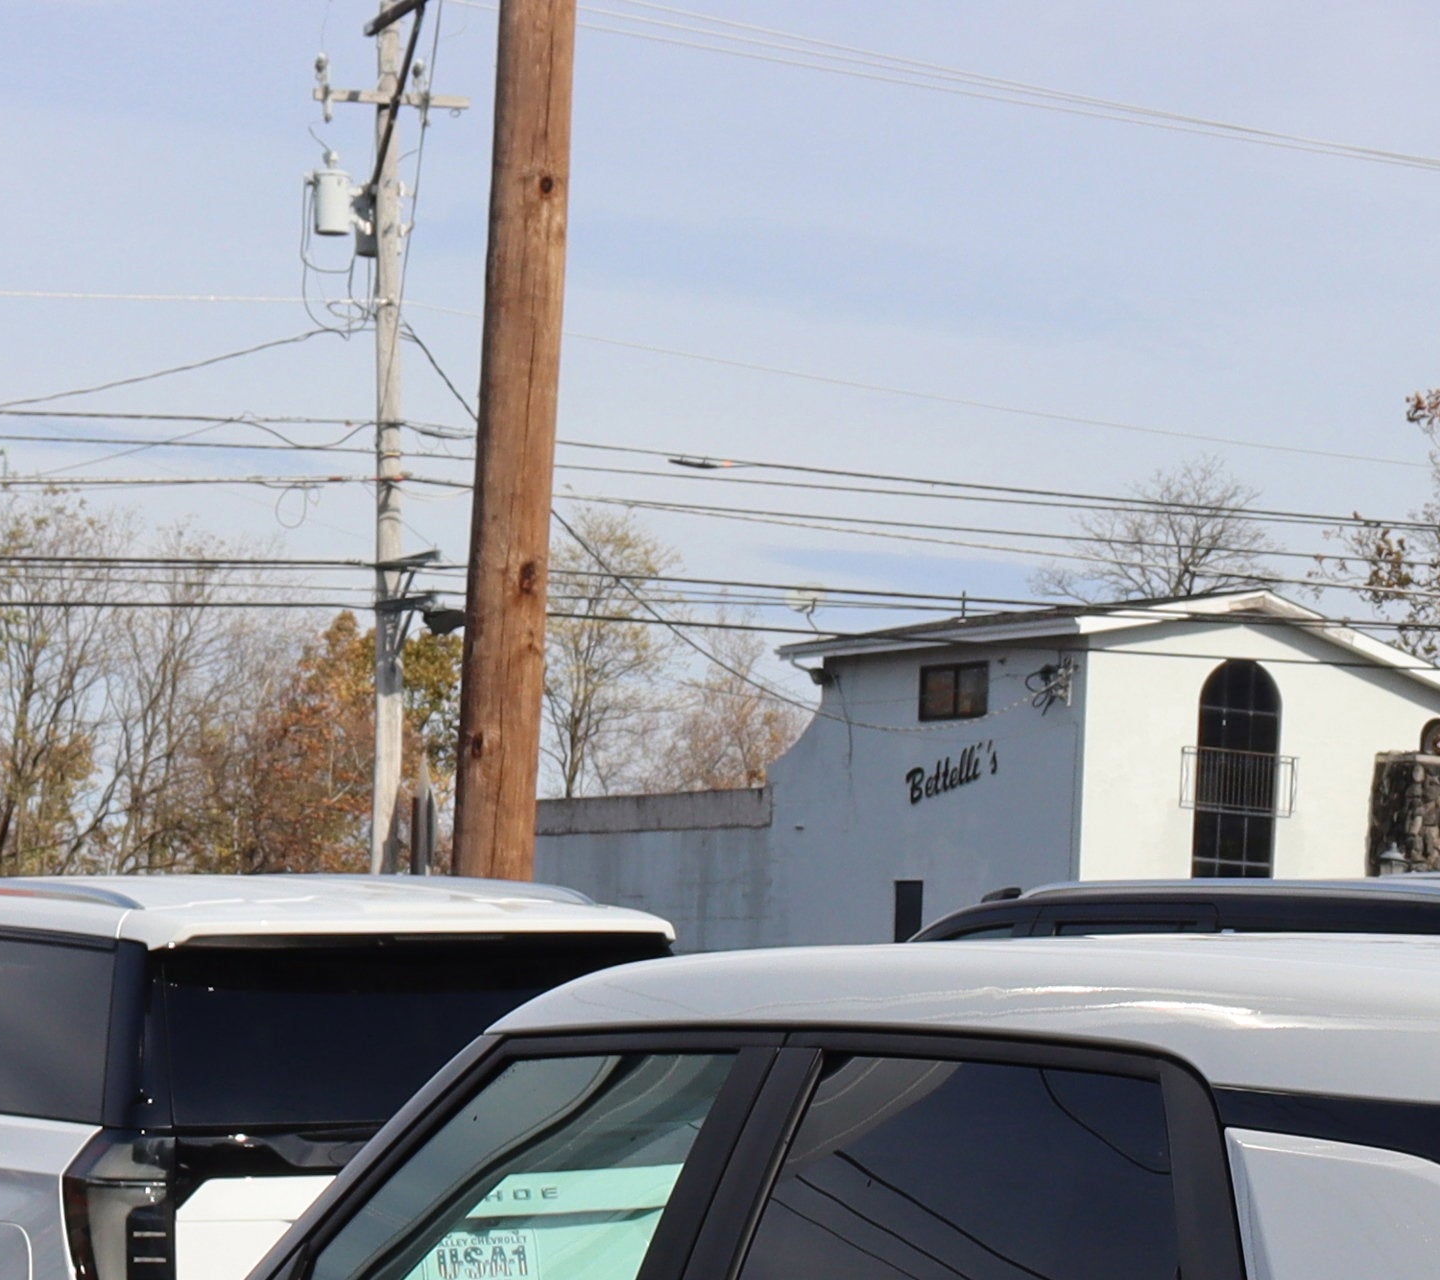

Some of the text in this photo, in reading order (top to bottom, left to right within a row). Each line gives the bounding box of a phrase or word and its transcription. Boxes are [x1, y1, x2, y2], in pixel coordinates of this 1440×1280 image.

[906, 740, 998, 804] Bettelli's
[484, 1187, 559, 1202] HOE
[439, 1235, 528, 1248] ALLEY CHEVROLET
